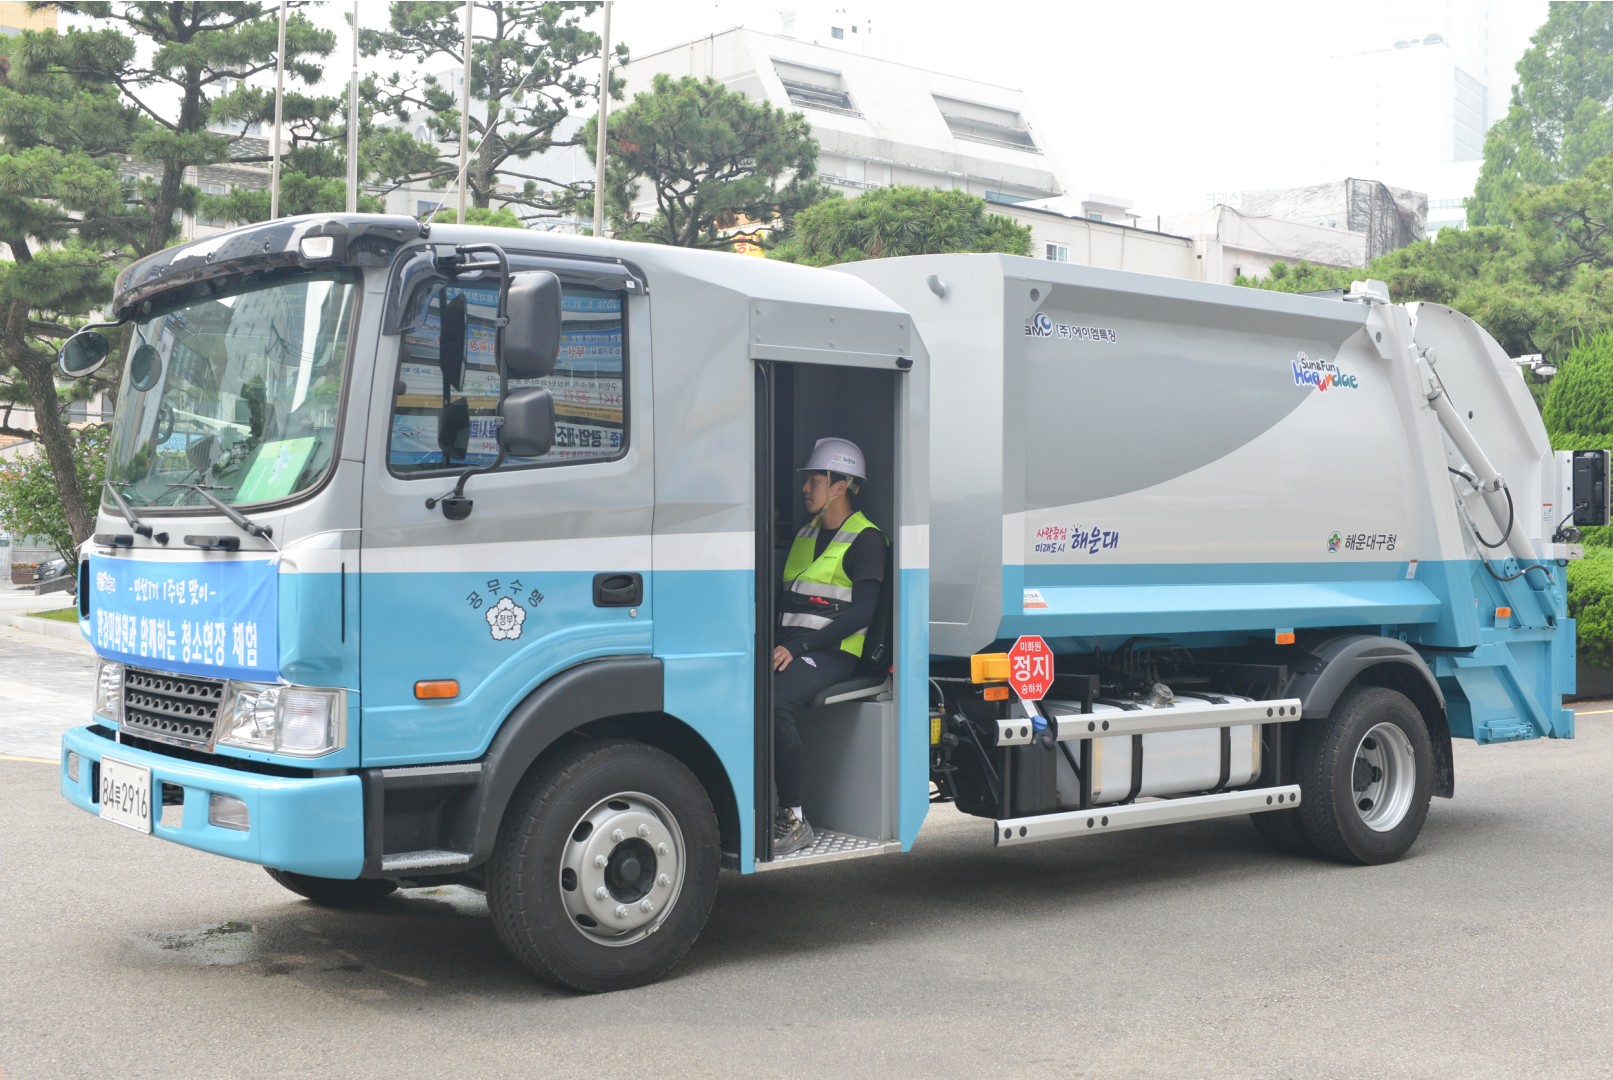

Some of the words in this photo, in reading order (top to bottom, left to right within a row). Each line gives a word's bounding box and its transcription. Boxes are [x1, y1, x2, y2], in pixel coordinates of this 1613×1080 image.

[1056, 324, 1116, 342] (주)에이엠특장
[1301, 358, 1336, 372] Sun&Fun
[1036, 526, 1067, 540] 사람중심
[1071, 525, 1119, 554] 해운대
[1035, 543, 1066, 553] 미래도시
[1345, 534, 1397, 551] 해운대구청
[466, 579, 545, 609] 공무수행
[500, 614, 513, 626] 정부
[97, 607, 137, 655] 환경미화원과
[140, 616, 177, 661] 함께하는
[181, 620, 227, 666] 청소현장
[232, 621, 258, 667] 체험
[1020, 641, 1042, 652] 미화원
[1013, 654, 1050, 682] 정지
[1021, 683, 1043, 695] 승하차
